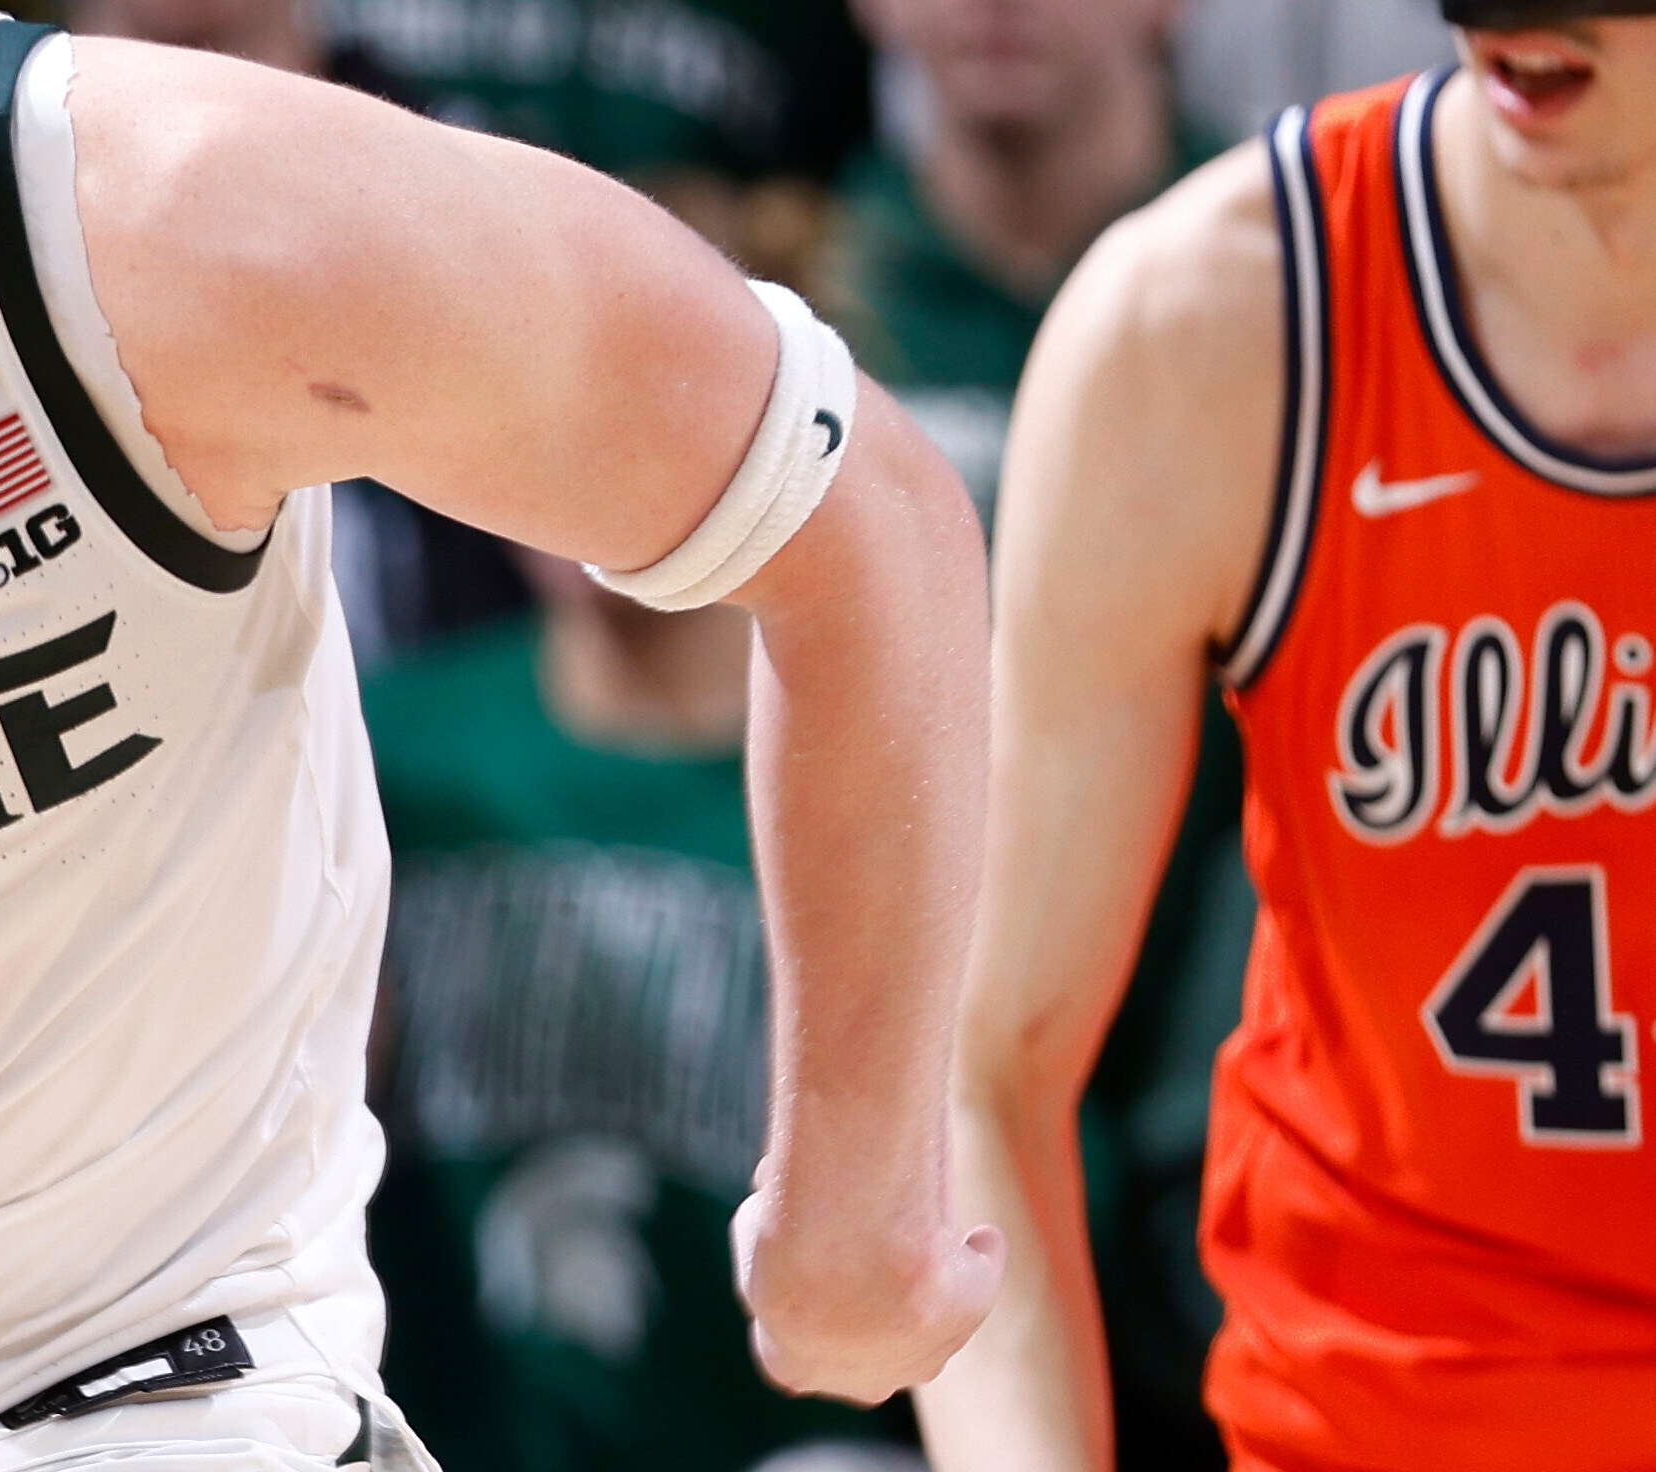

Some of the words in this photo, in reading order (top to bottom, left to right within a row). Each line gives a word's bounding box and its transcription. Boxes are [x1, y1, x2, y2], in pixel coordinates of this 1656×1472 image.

[1326, 600, 1656, 847] Illi
[1420, 862, 1656, 1149] 4
[182, 1328, 227, 1357] 48
